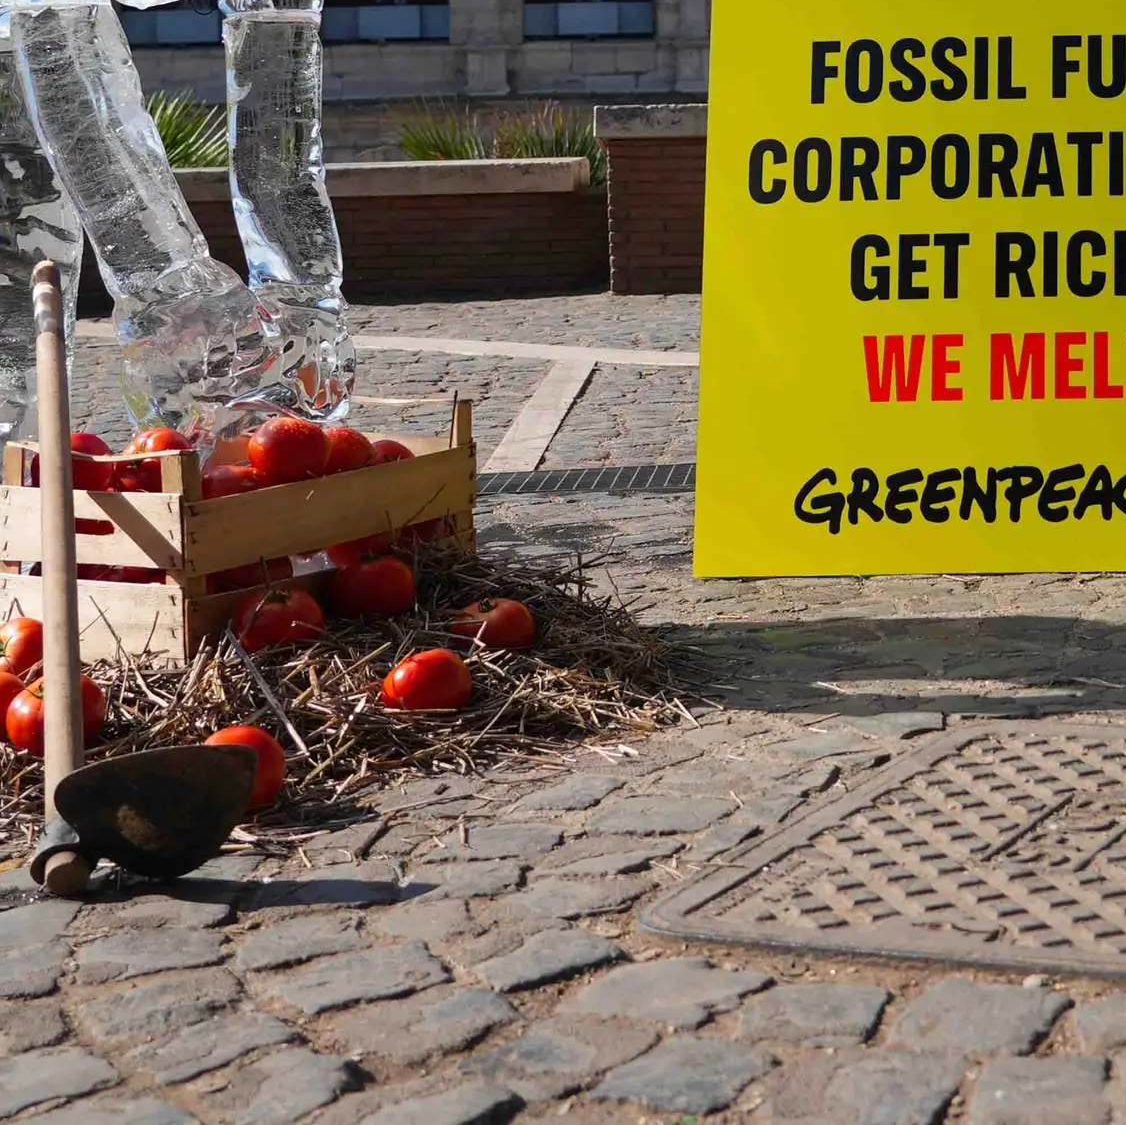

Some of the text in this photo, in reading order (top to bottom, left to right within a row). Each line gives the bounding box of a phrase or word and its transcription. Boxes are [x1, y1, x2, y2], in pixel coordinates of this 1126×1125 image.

[811, 36, 1026, 104] FOSSIL
[851, 233, 969, 301] GET
[863, 334, 963, 402] WE
